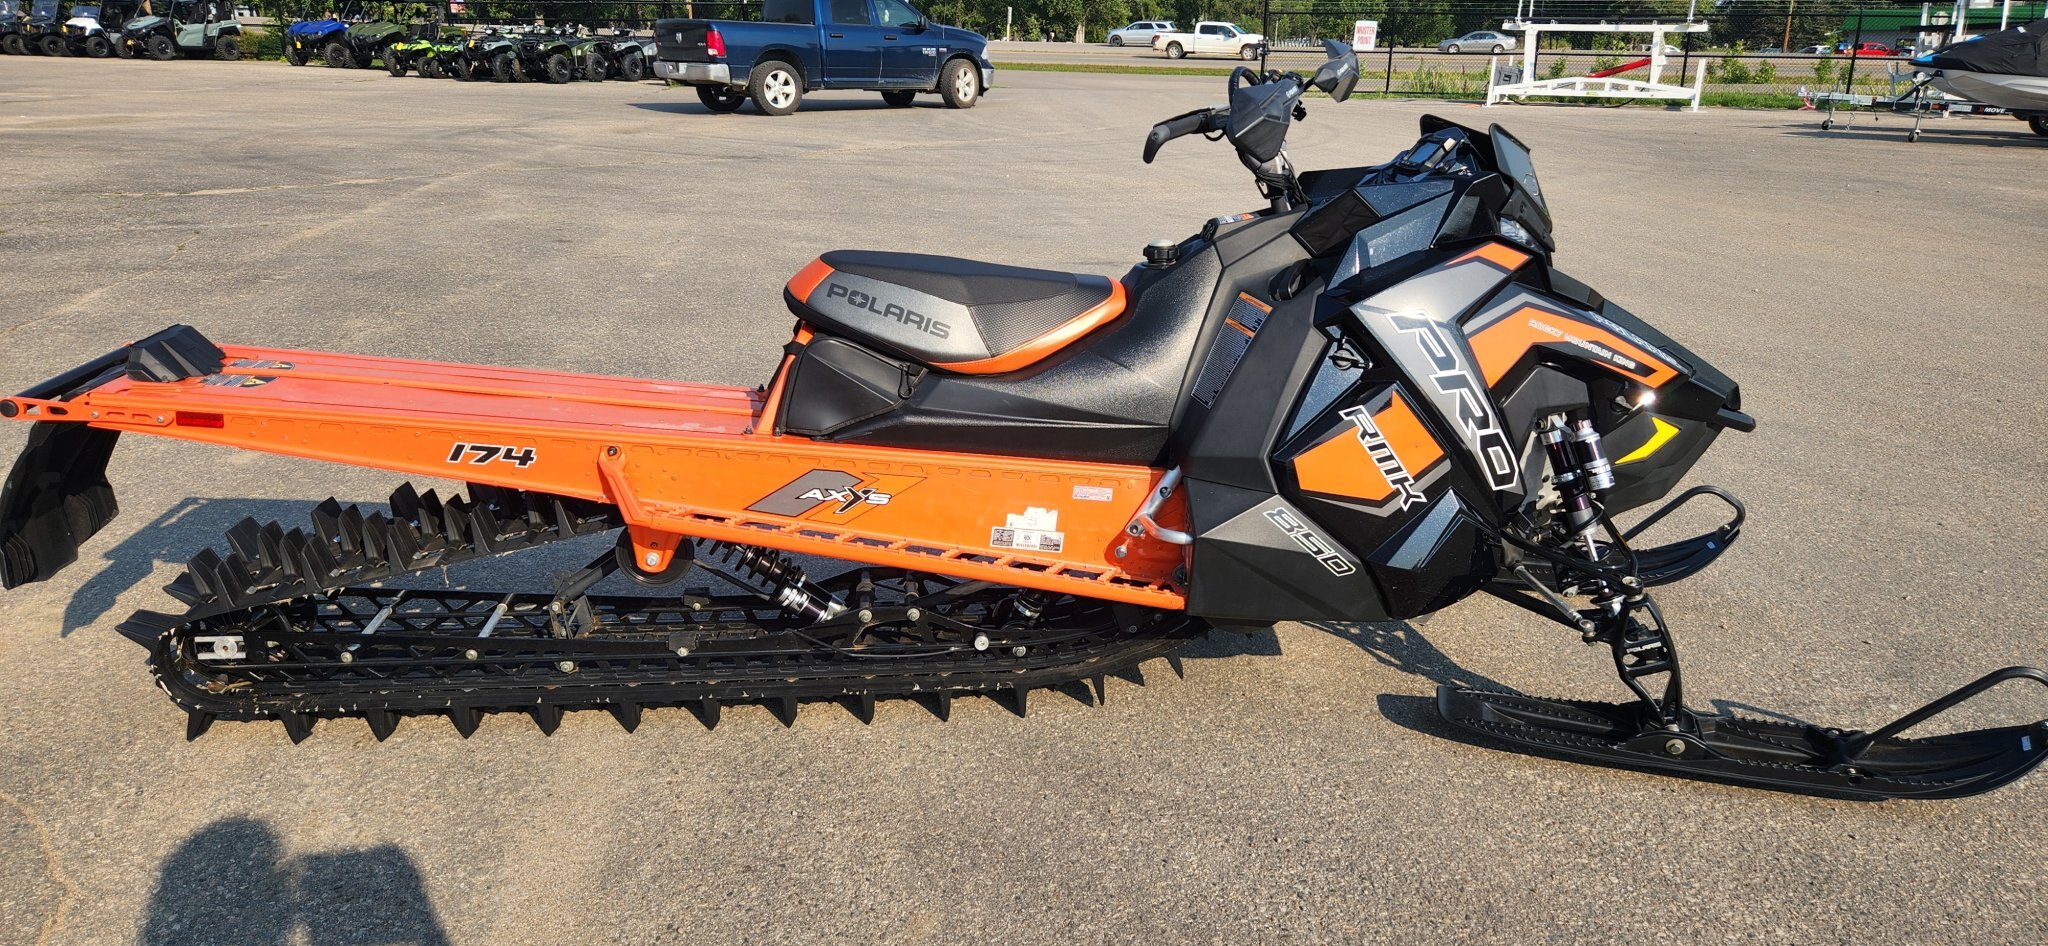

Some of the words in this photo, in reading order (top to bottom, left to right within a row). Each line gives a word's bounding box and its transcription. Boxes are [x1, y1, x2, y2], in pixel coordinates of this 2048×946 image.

[826, 282, 952, 340] POLARIS
[1528, 318, 1564, 338] ROCKY
[1563, 332, 1613, 360] MOUNTAIN
[1612, 353, 1636, 370] KING
[1384, 309, 1519, 491] PRO
[446, 441, 538, 469] 174
[1338, 404, 1428, 512] RMK
[795, 486, 893, 514] AXYS
[1262, 506, 1357, 577] 850
